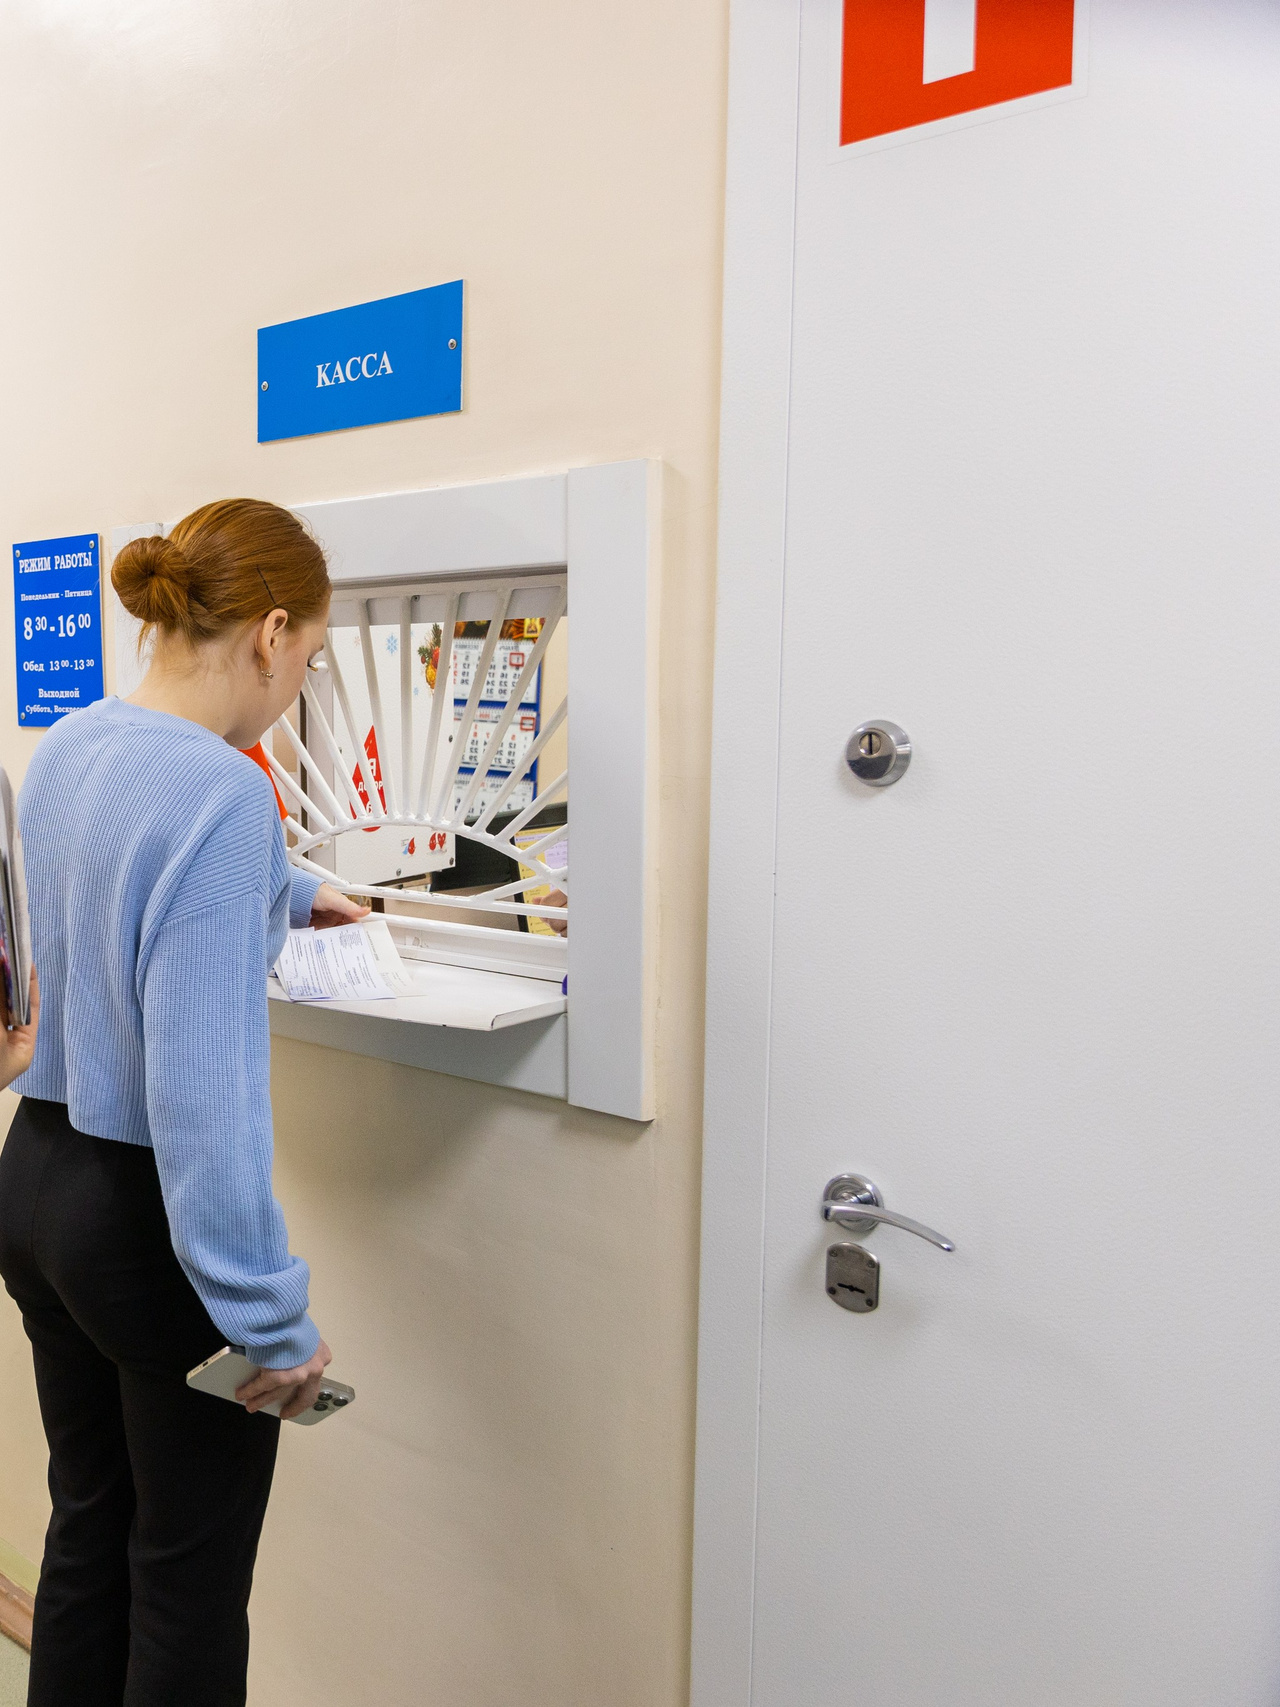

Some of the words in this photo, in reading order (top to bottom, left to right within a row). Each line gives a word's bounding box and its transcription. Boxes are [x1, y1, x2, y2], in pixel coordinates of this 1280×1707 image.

[315, 350, 394, 389] КАССА
[18, 556, 52, 574] РЕЖИМ
[54, 551, 93, 570] РАБОТЫ
[20, 592, 60, 602] Понедельник
[64, 589, 93, 598] Пятница
[22, 660, 45, 672] Обед
[38, 687, 80, 699] Выходной
[25, 704, 53, 715] Суббота,
